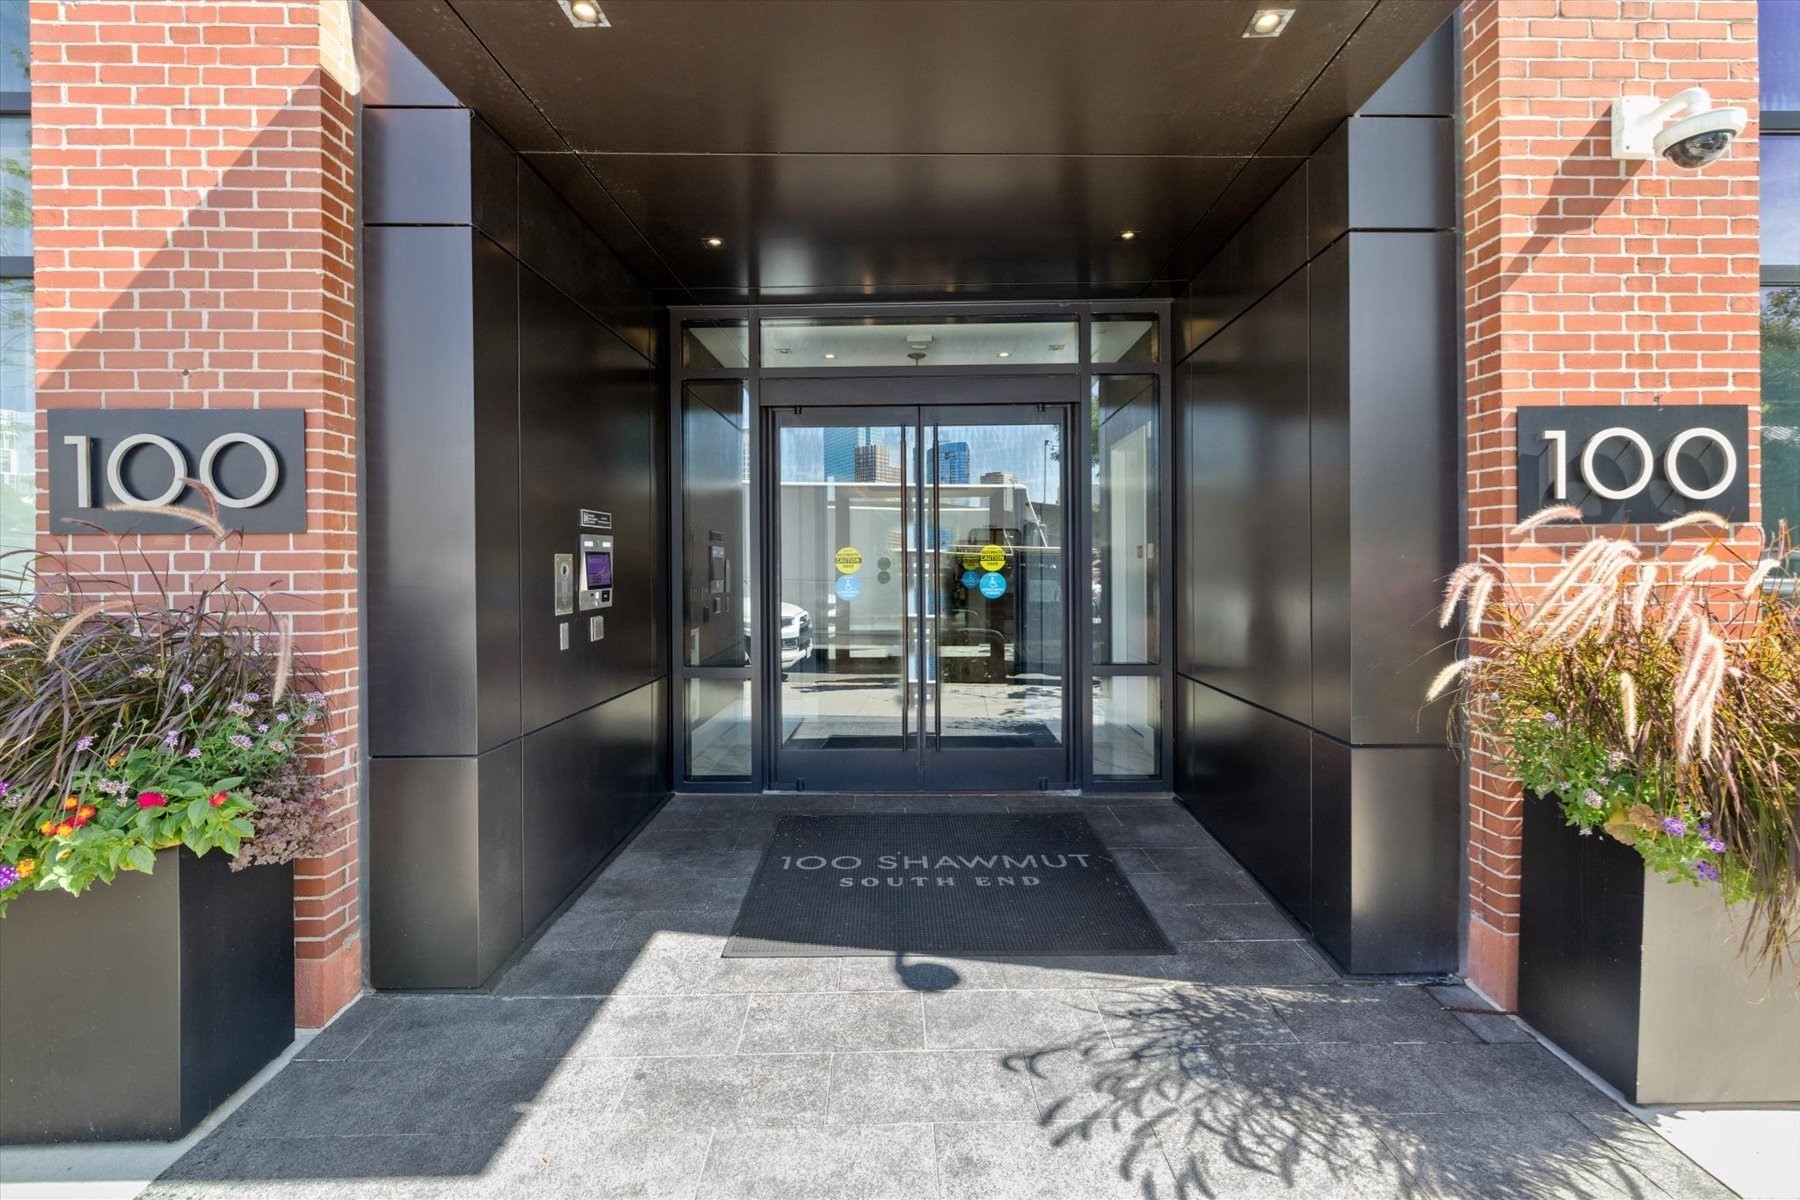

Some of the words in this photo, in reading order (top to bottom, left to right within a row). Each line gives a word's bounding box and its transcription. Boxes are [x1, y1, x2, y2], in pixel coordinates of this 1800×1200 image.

[64, 432, 279, 509] 100
[1541, 427, 1737, 500] 100
[781, 855, 862, 870] 100
[877, 854, 1090, 870] SHAWMUT
[839, 876, 955, 888] SOUTH
[975, 876, 1041, 887] END
